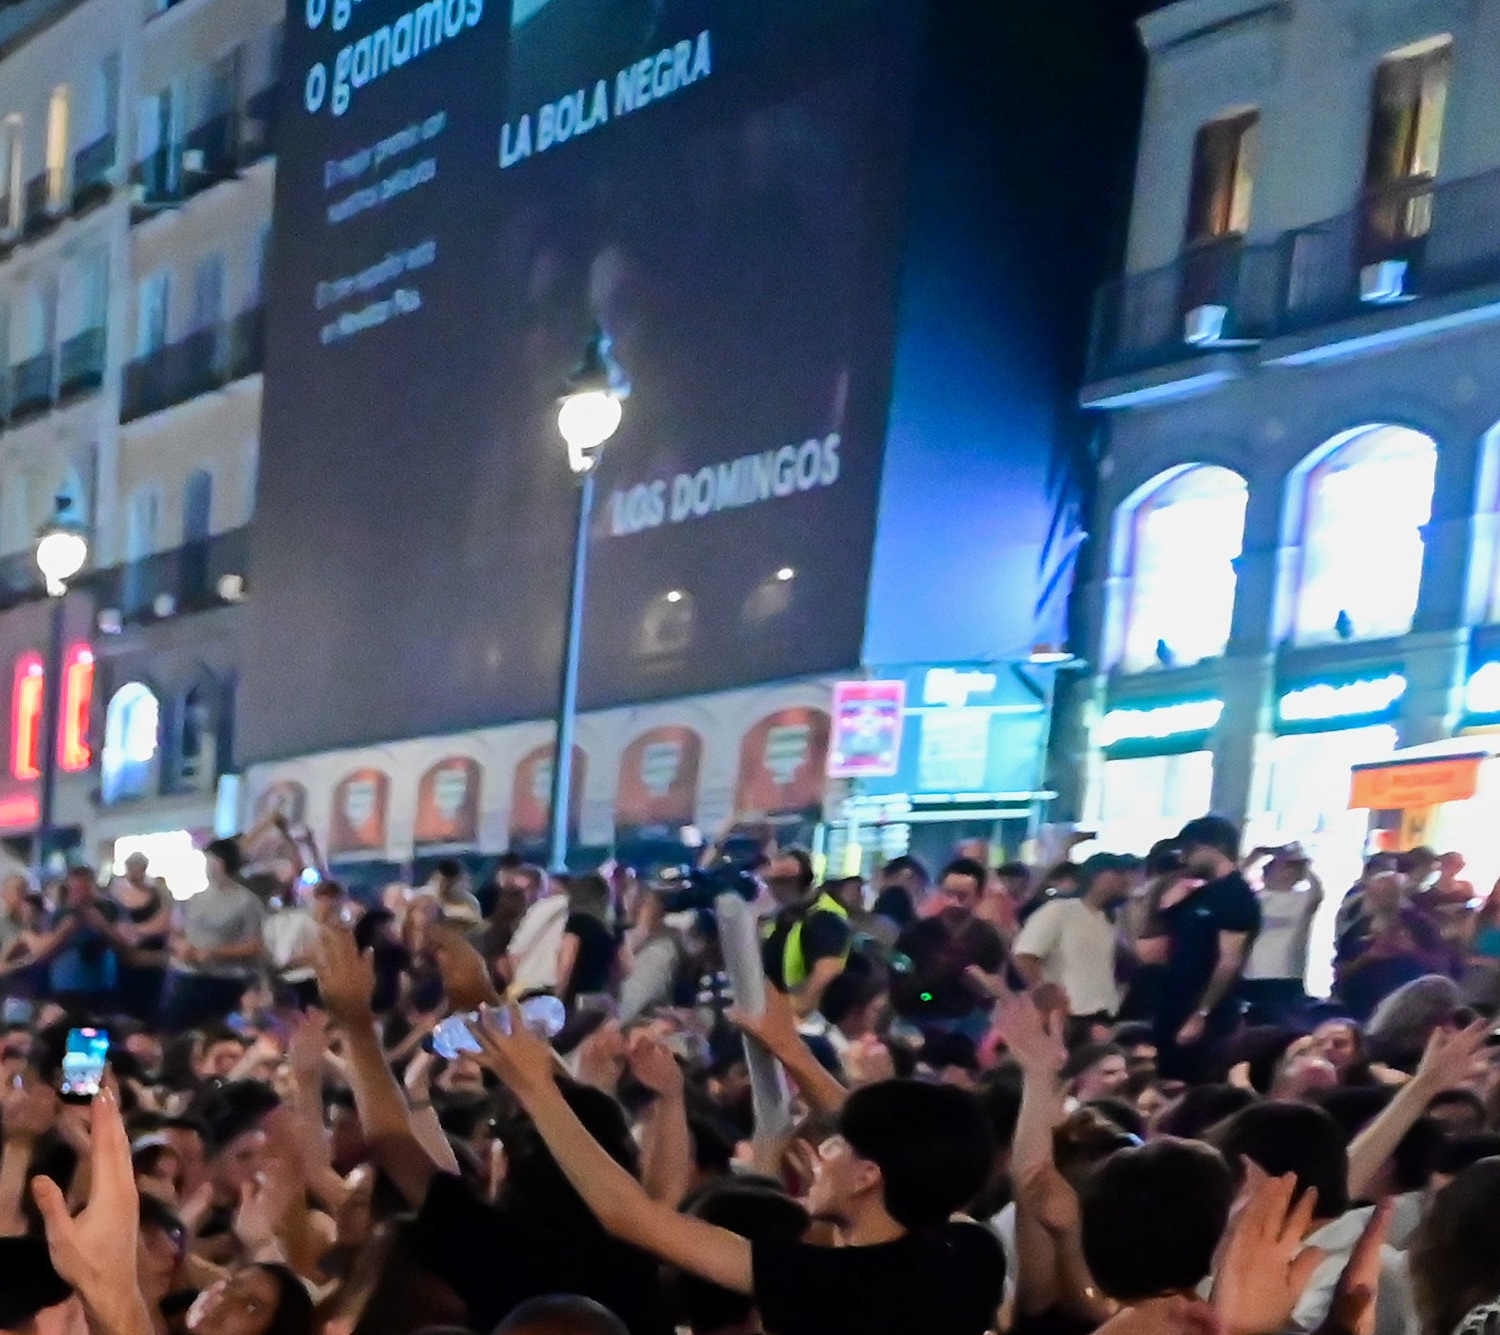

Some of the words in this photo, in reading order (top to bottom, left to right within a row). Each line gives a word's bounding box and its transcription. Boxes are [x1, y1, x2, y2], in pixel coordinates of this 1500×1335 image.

[332, 0, 483, 117] ganamos
[499, 113, 531, 169] LA
[536, 78, 609, 153] BOLA
[614, 29, 712, 118] NEGRA
[612, 480, 666, 536] LOS
[671, 432, 841, 522] DOMINGOS
